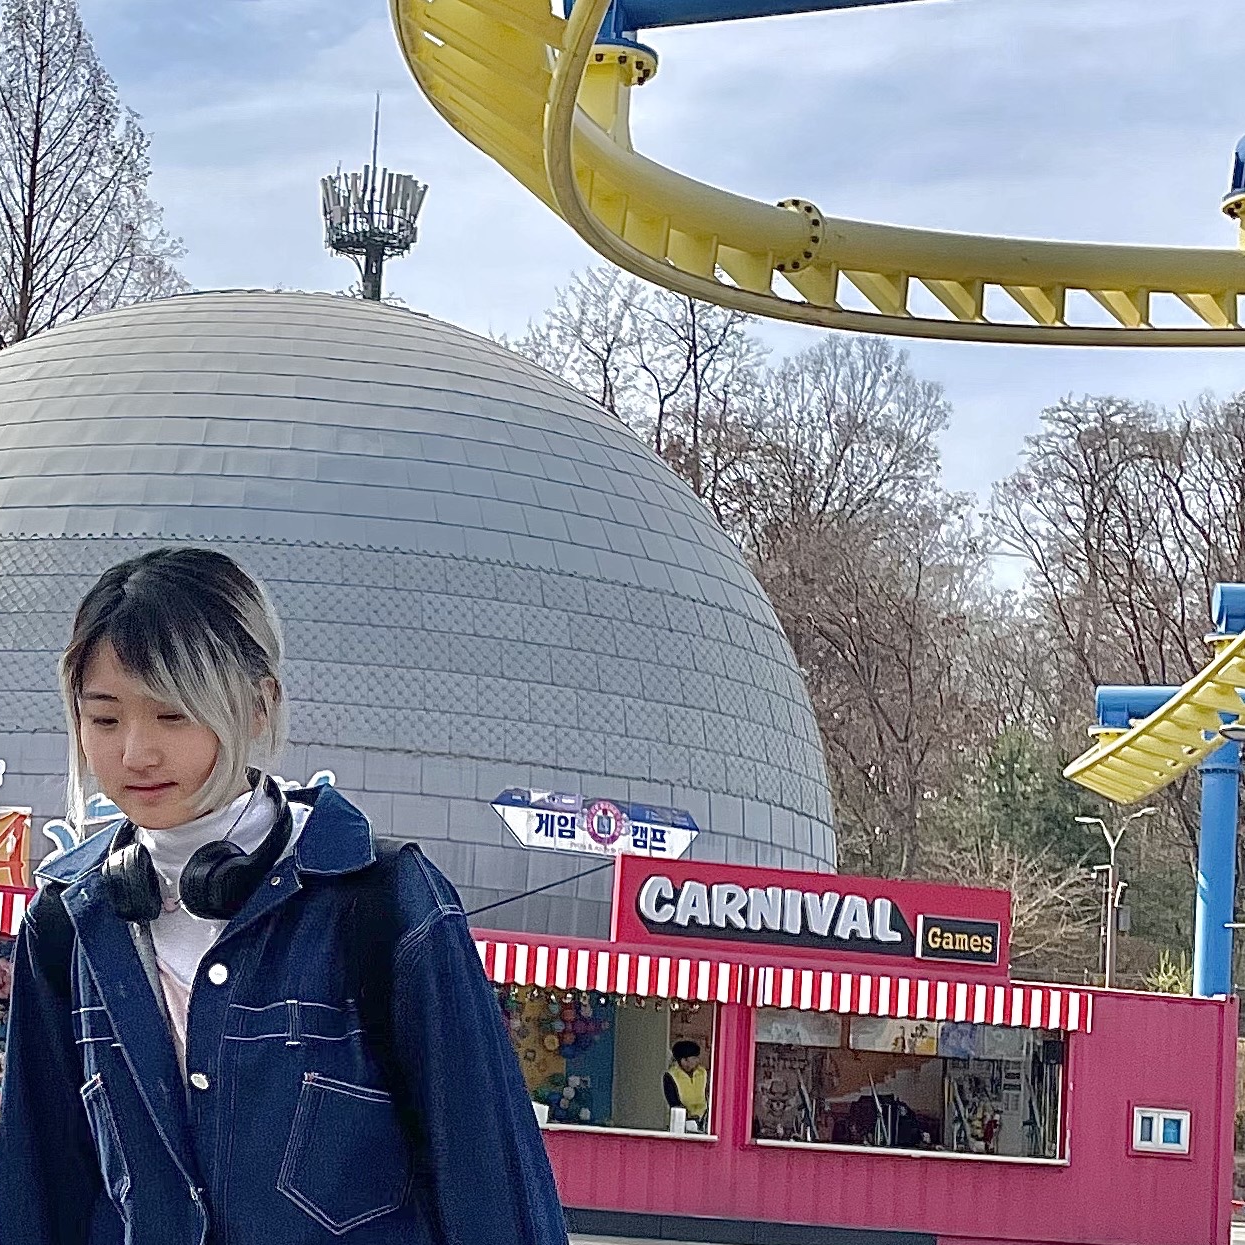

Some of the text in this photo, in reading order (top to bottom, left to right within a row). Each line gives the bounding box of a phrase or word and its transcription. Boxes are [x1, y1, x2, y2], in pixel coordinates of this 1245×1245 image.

[534, 812, 577, 839] 게임
[631, 824, 667, 852] 캠프
[639, 875, 902, 944] CARNIVAL
[926, 926, 994, 955] Games
